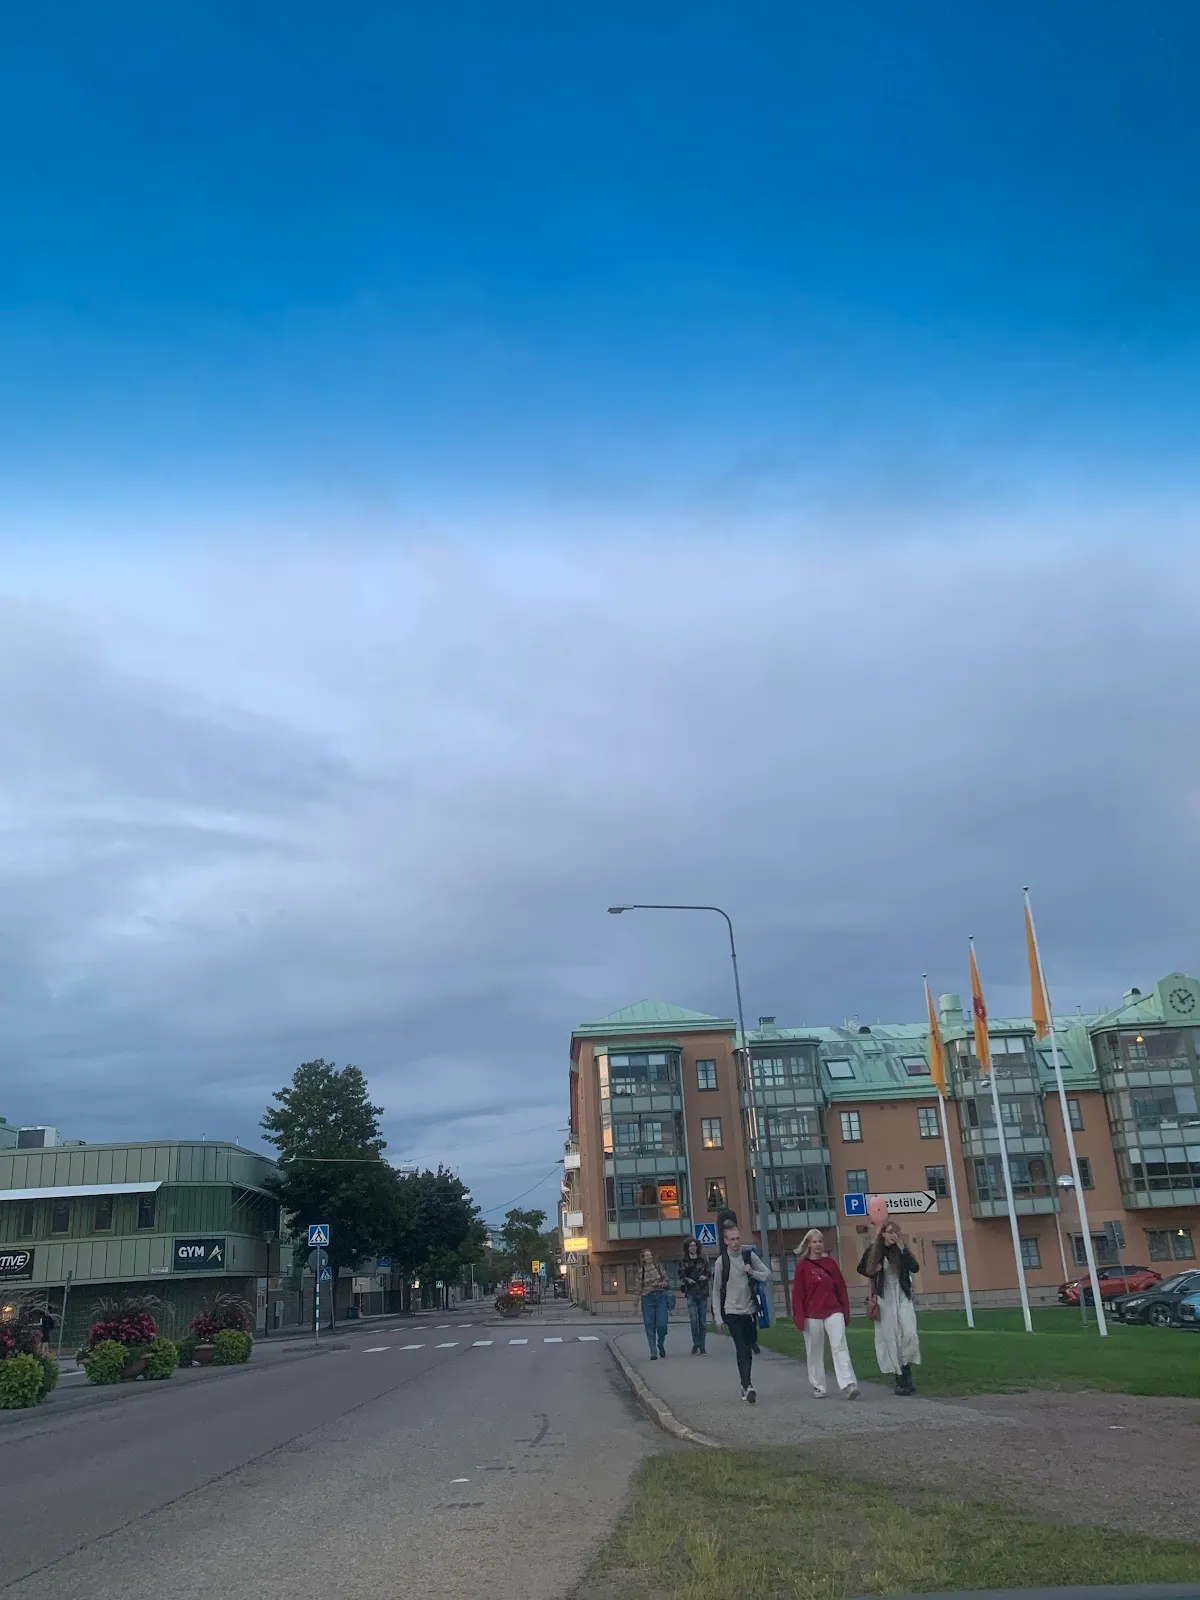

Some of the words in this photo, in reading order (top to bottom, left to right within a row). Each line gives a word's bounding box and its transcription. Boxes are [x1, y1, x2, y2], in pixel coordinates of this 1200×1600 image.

[851, 1199, 859, 1210] P
[881, 1198, 923, 1208] stställe
[178, 1246, 205, 1258] GYM
